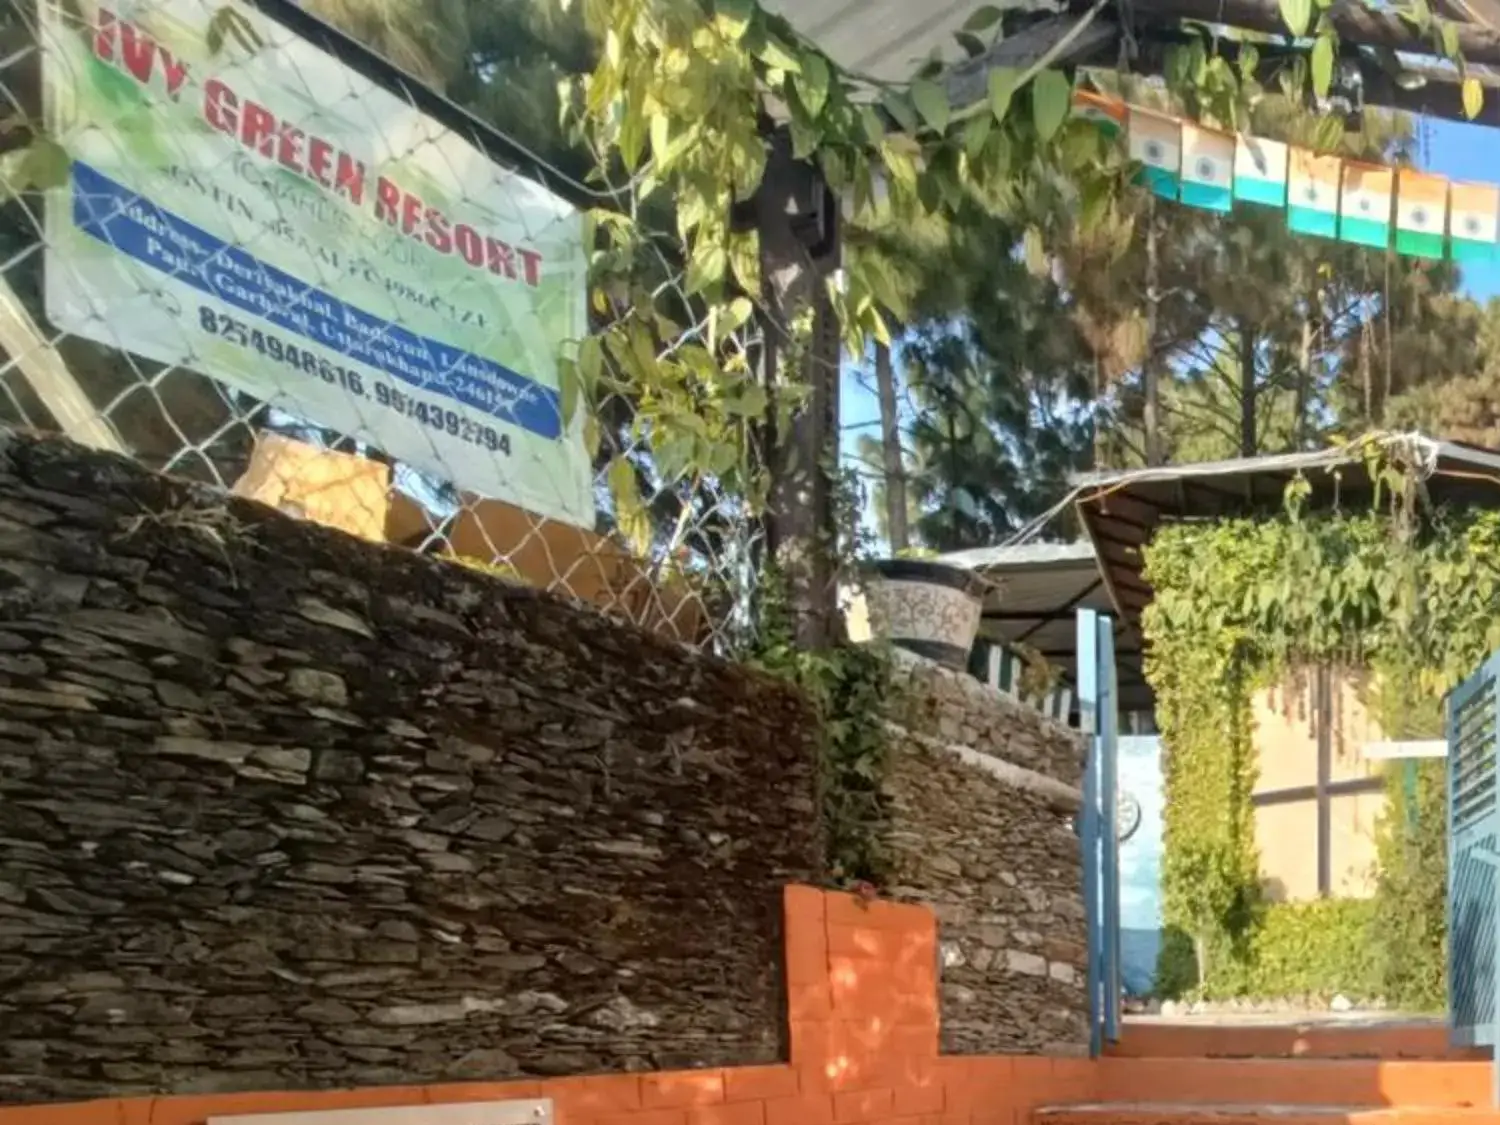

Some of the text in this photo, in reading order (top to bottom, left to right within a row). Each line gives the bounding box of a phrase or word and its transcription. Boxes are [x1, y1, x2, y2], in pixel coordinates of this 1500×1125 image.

[94, 7, 542, 287] IVY GREEN RESORT
